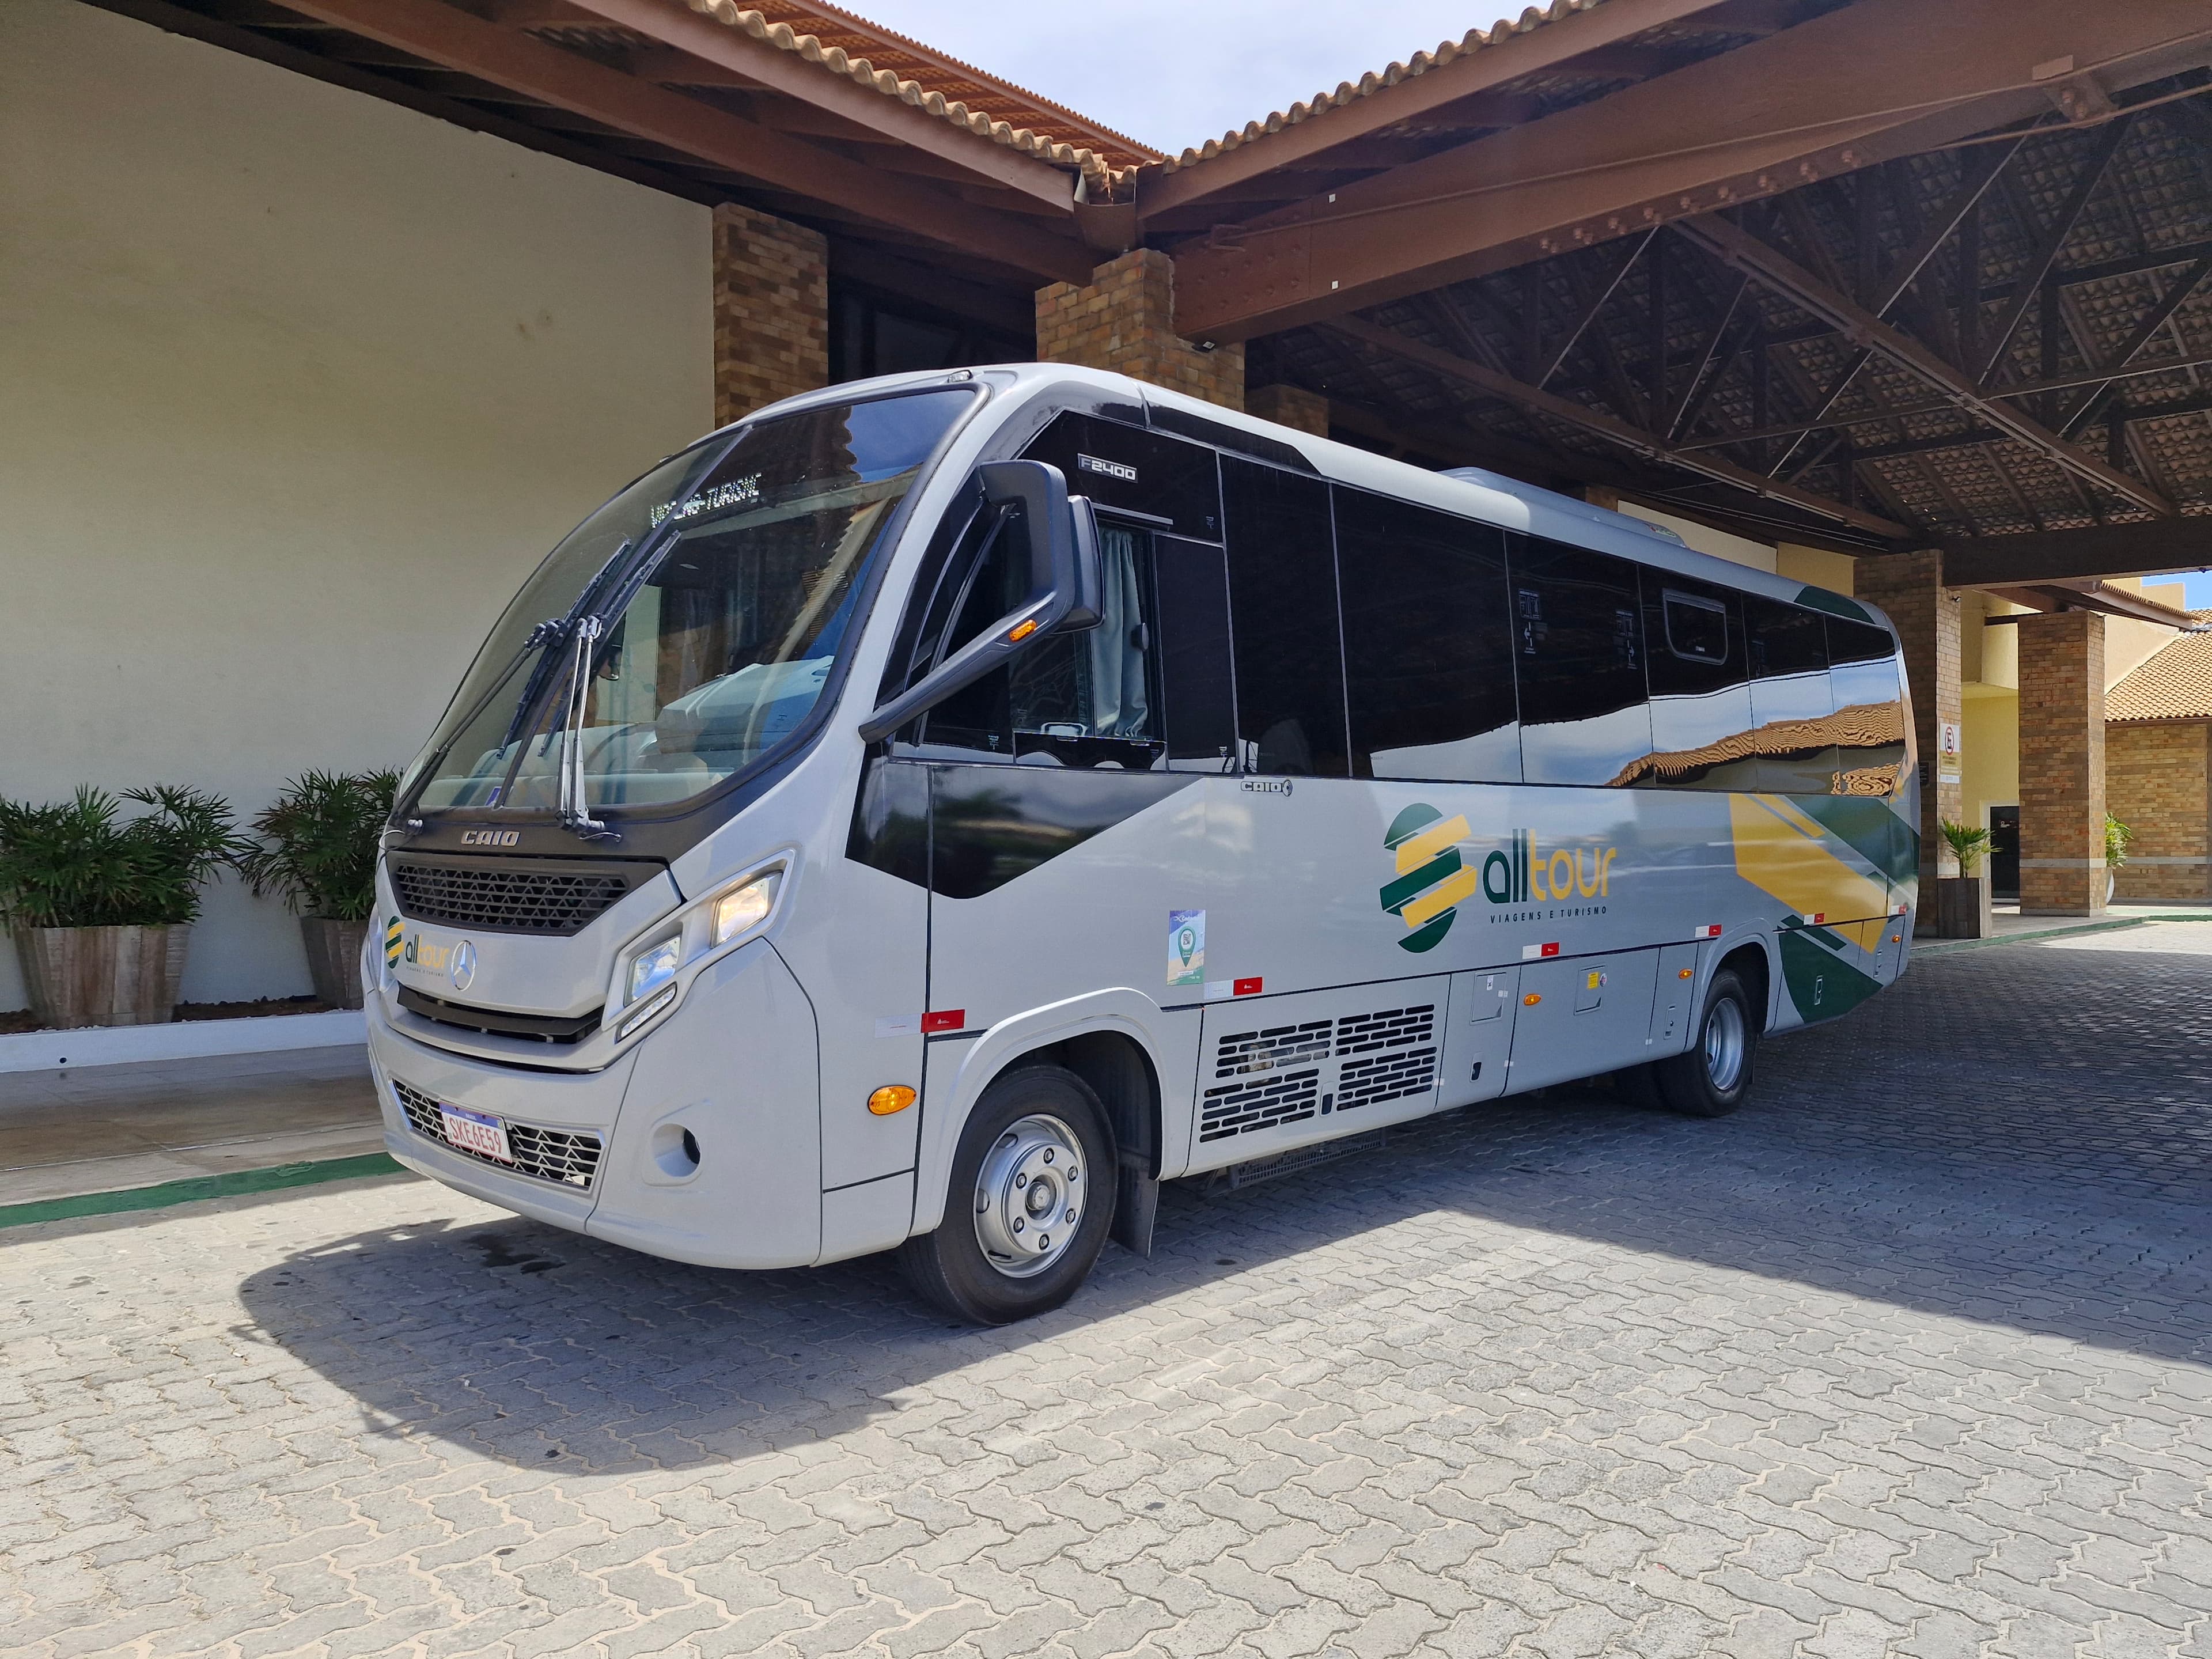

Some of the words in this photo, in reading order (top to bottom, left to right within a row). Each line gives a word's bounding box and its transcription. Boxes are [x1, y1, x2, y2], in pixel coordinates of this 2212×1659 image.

[1081, 457, 1136, 480] F2400
[1241, 781, 1283, 793] CAIO
[461, 830, 520, 847] CAIO
[1483, 828, 1618, 904] alltour
[1490, 911, 1541, 924] VIAGENS
[1550, 910, 1554, 919] E
[1560, 906, 1607, 918] TURISMO
[406, 934, 450, 969] alltour
[449, 1117, 502, 1154] SKE6E59
